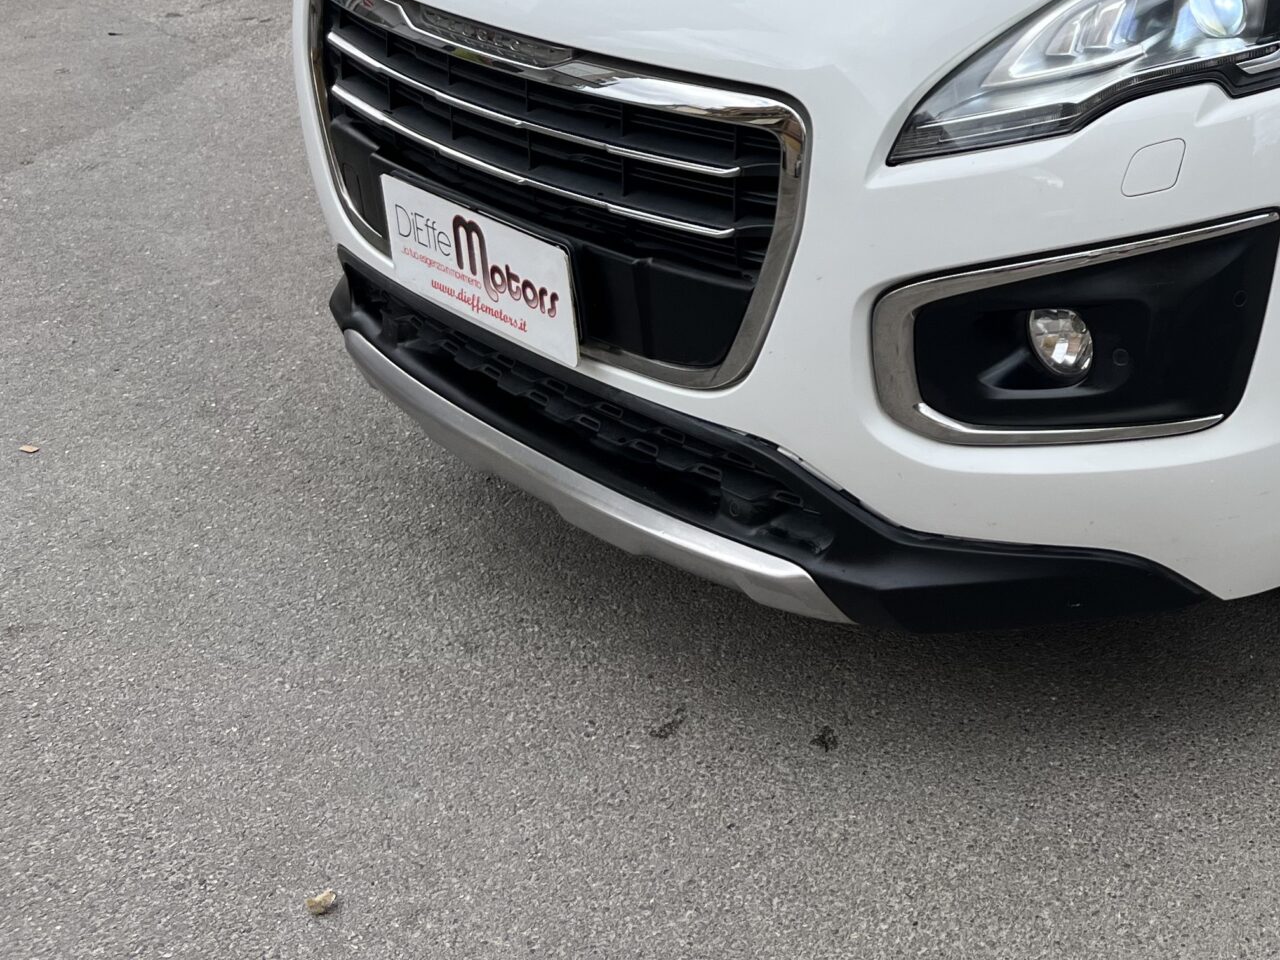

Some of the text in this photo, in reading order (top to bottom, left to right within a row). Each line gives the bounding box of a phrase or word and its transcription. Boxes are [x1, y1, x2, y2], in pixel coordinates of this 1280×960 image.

[395, 204, 559, 318] DiEffe Motors
[431, 279, 528, 332] www.dieffemotors.it
